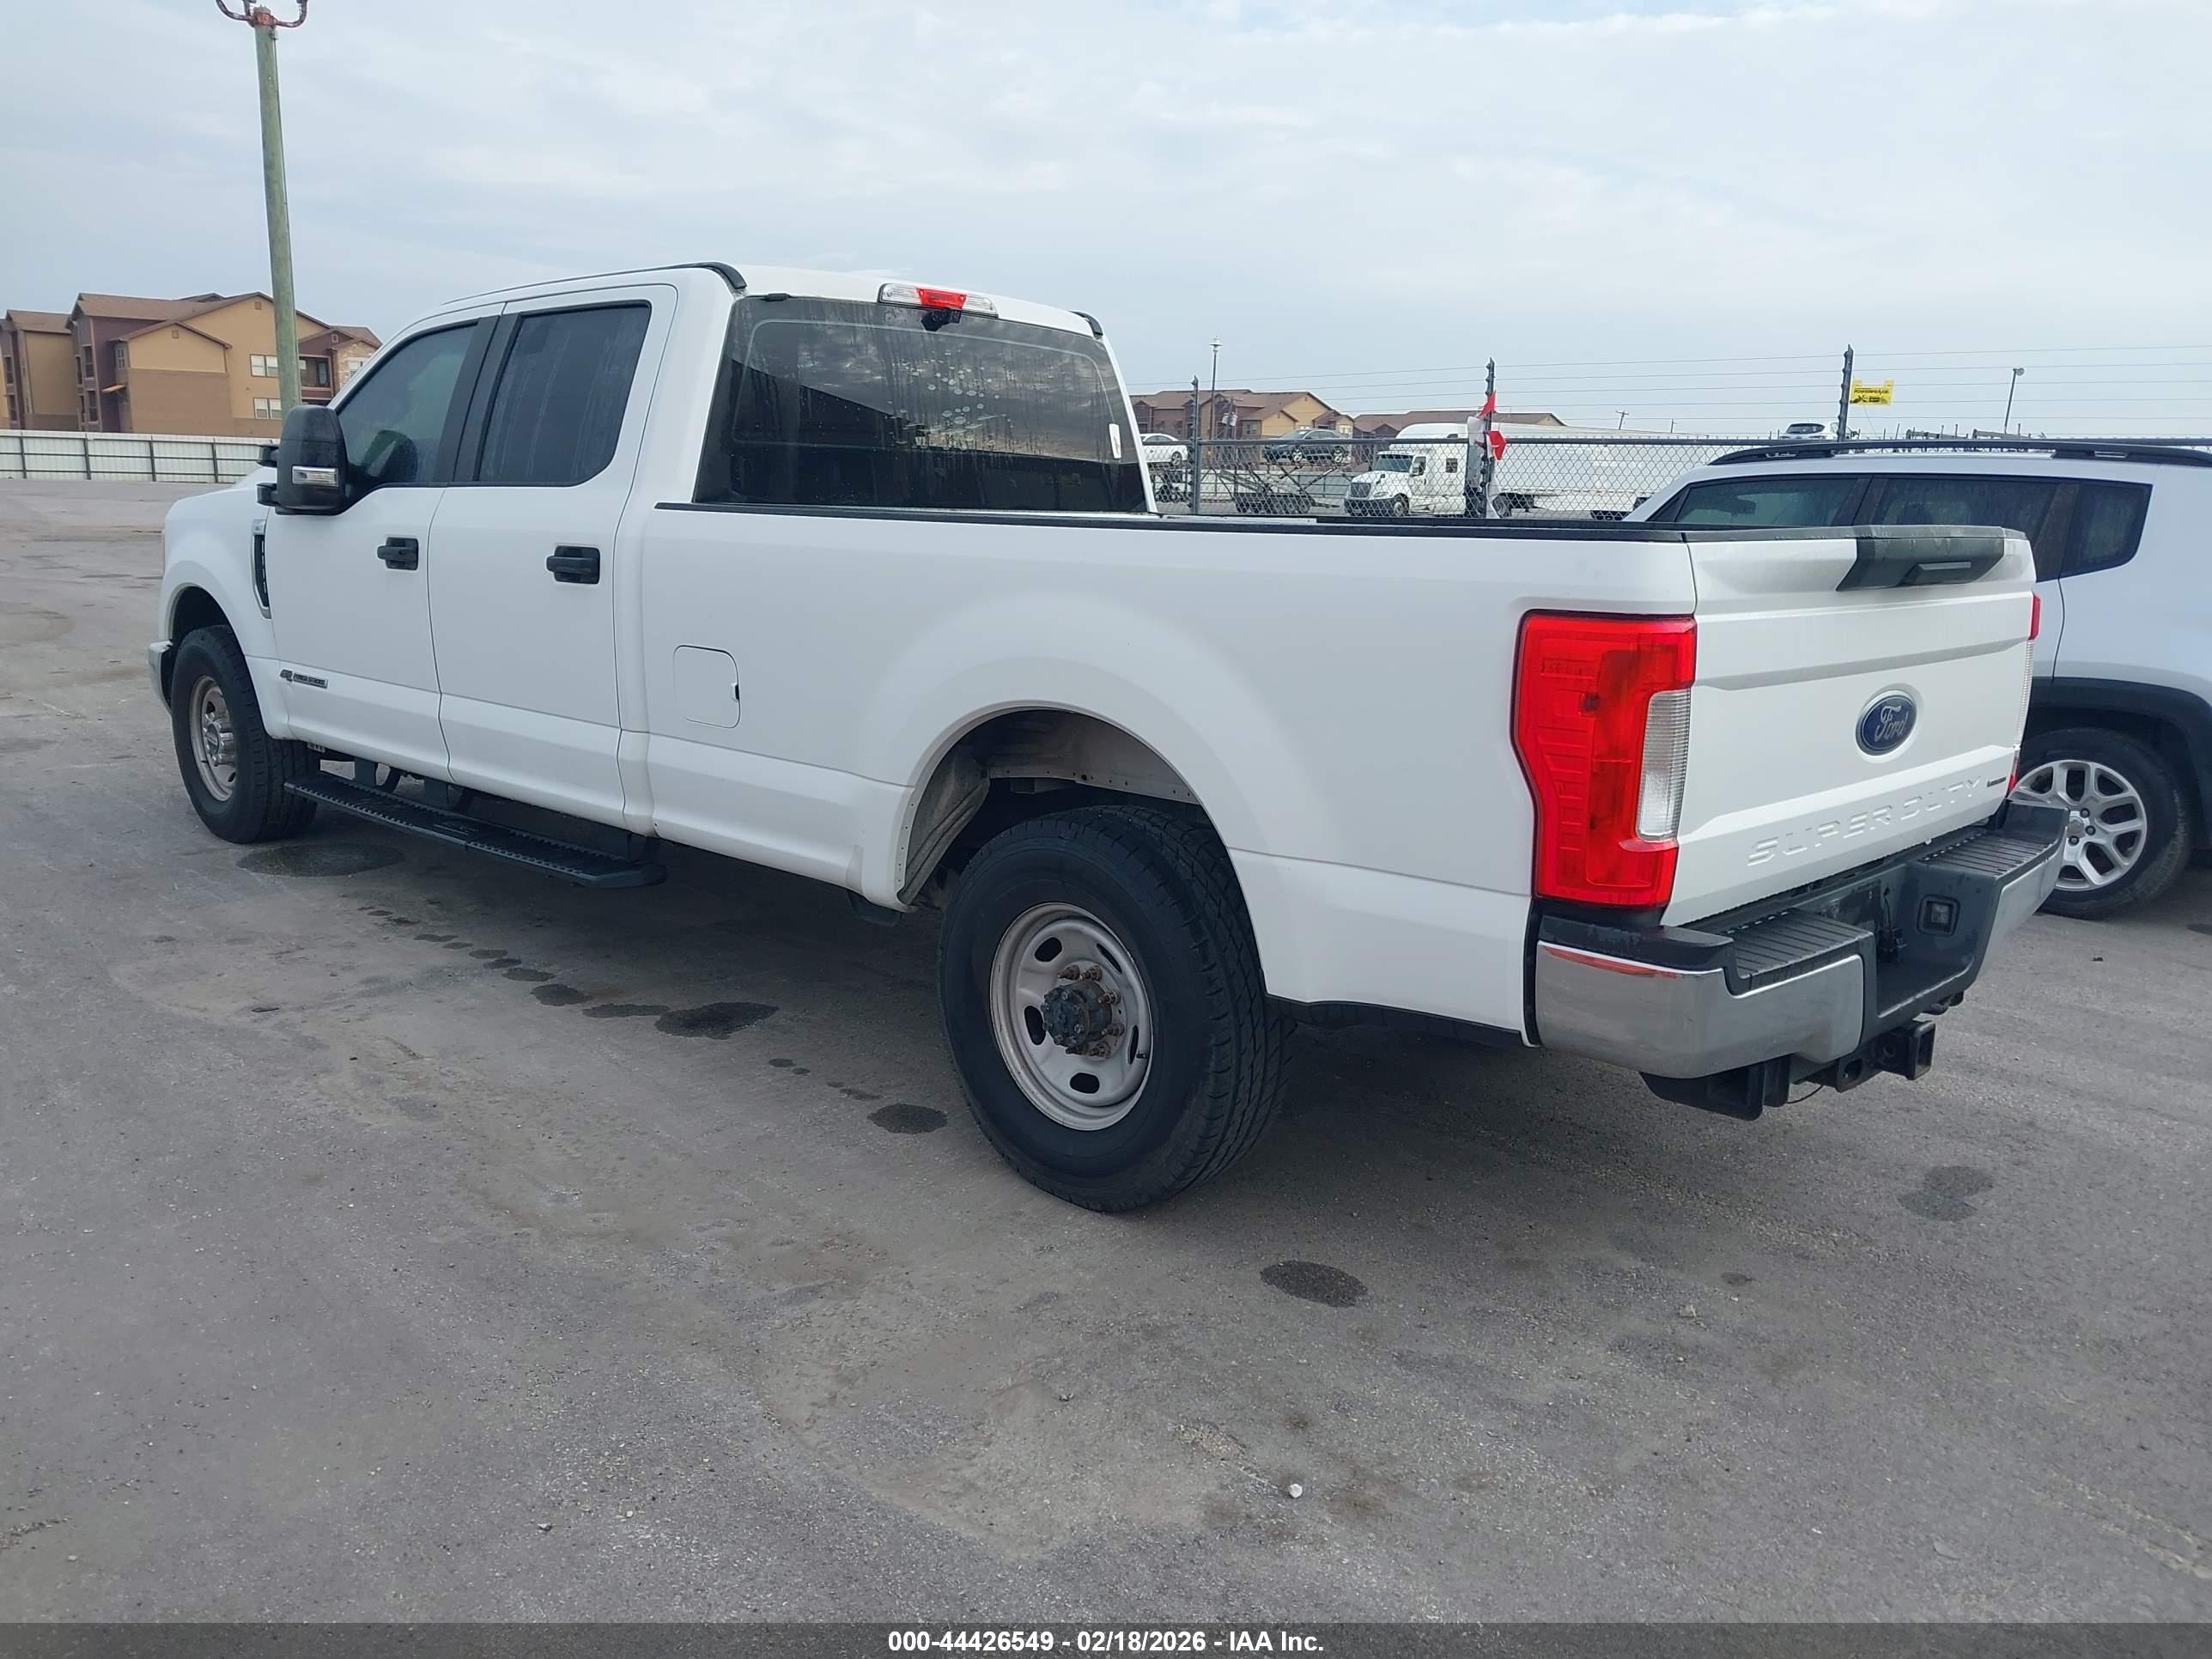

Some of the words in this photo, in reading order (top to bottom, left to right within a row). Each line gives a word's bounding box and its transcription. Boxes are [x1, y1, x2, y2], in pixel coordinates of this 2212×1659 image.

[1874, 705, 1910, 742] Ford
[1747, 804, 1893, 866] SUPER
[1899, 775, 1982, 821] DUTY
